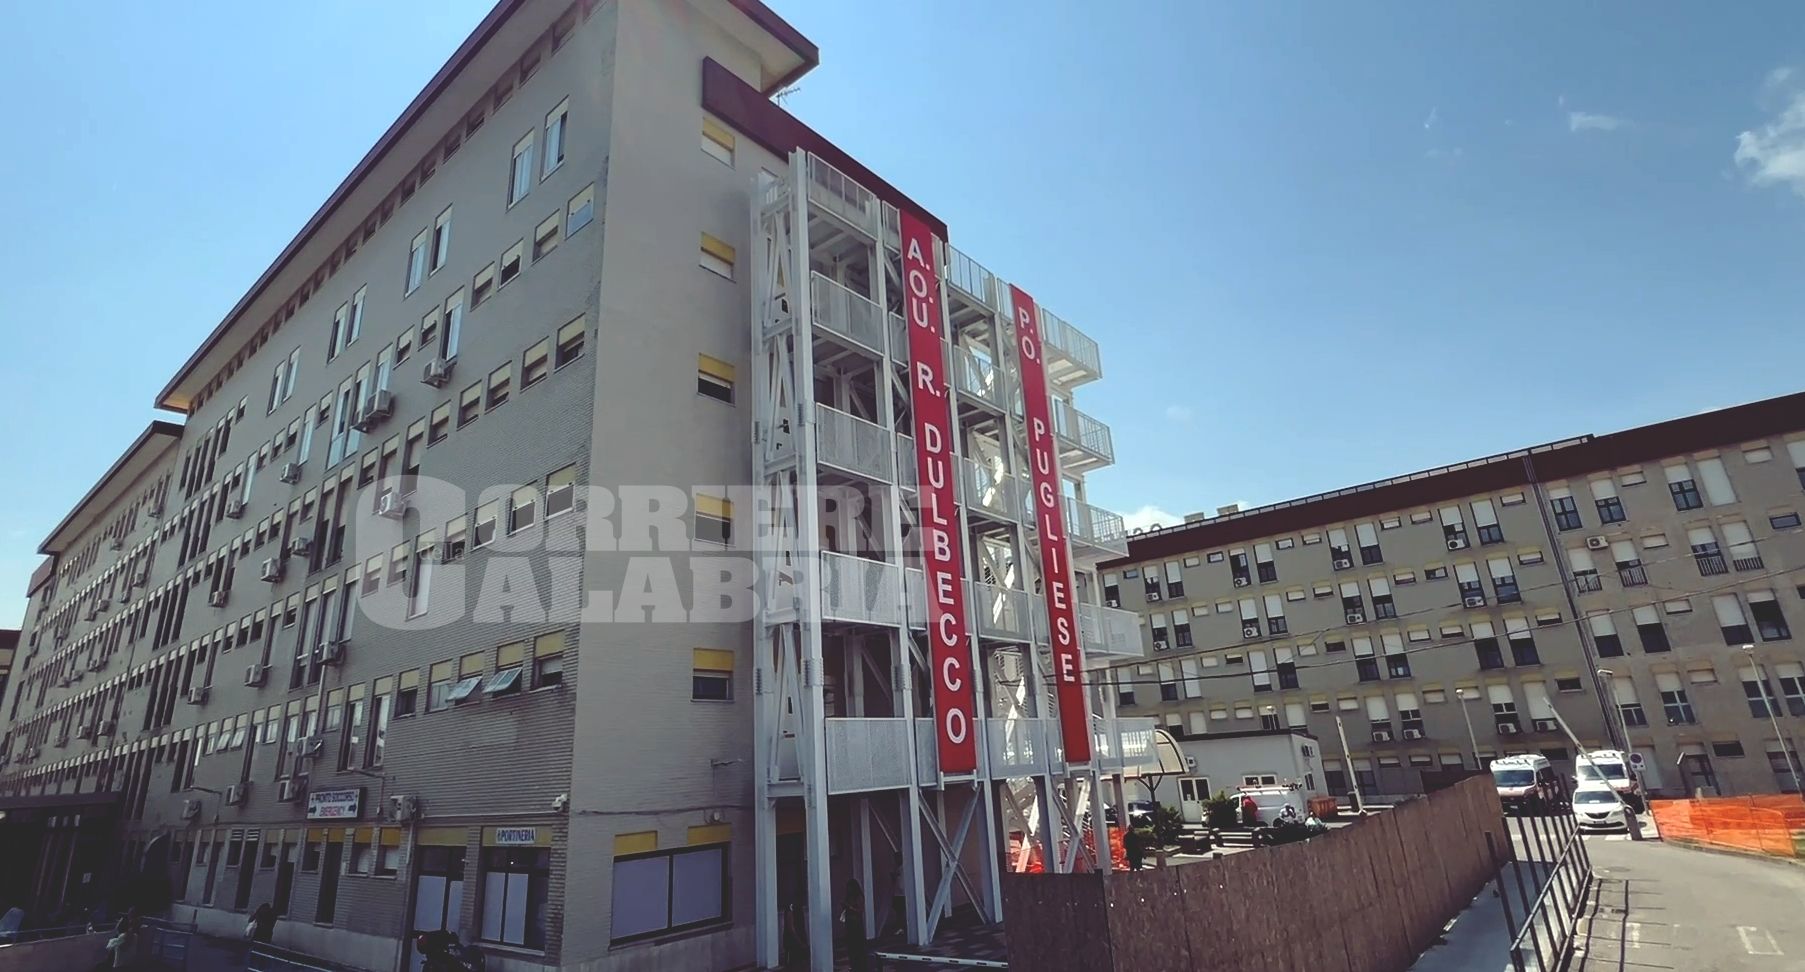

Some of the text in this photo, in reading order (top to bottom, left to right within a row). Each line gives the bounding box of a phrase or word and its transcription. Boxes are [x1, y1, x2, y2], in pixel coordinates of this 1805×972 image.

[916, 361, 941, 397] R.
[1018, 306, 1075, 682] P.O. PUGLIESE
[924, 422, 967, 744] DULBECCO
